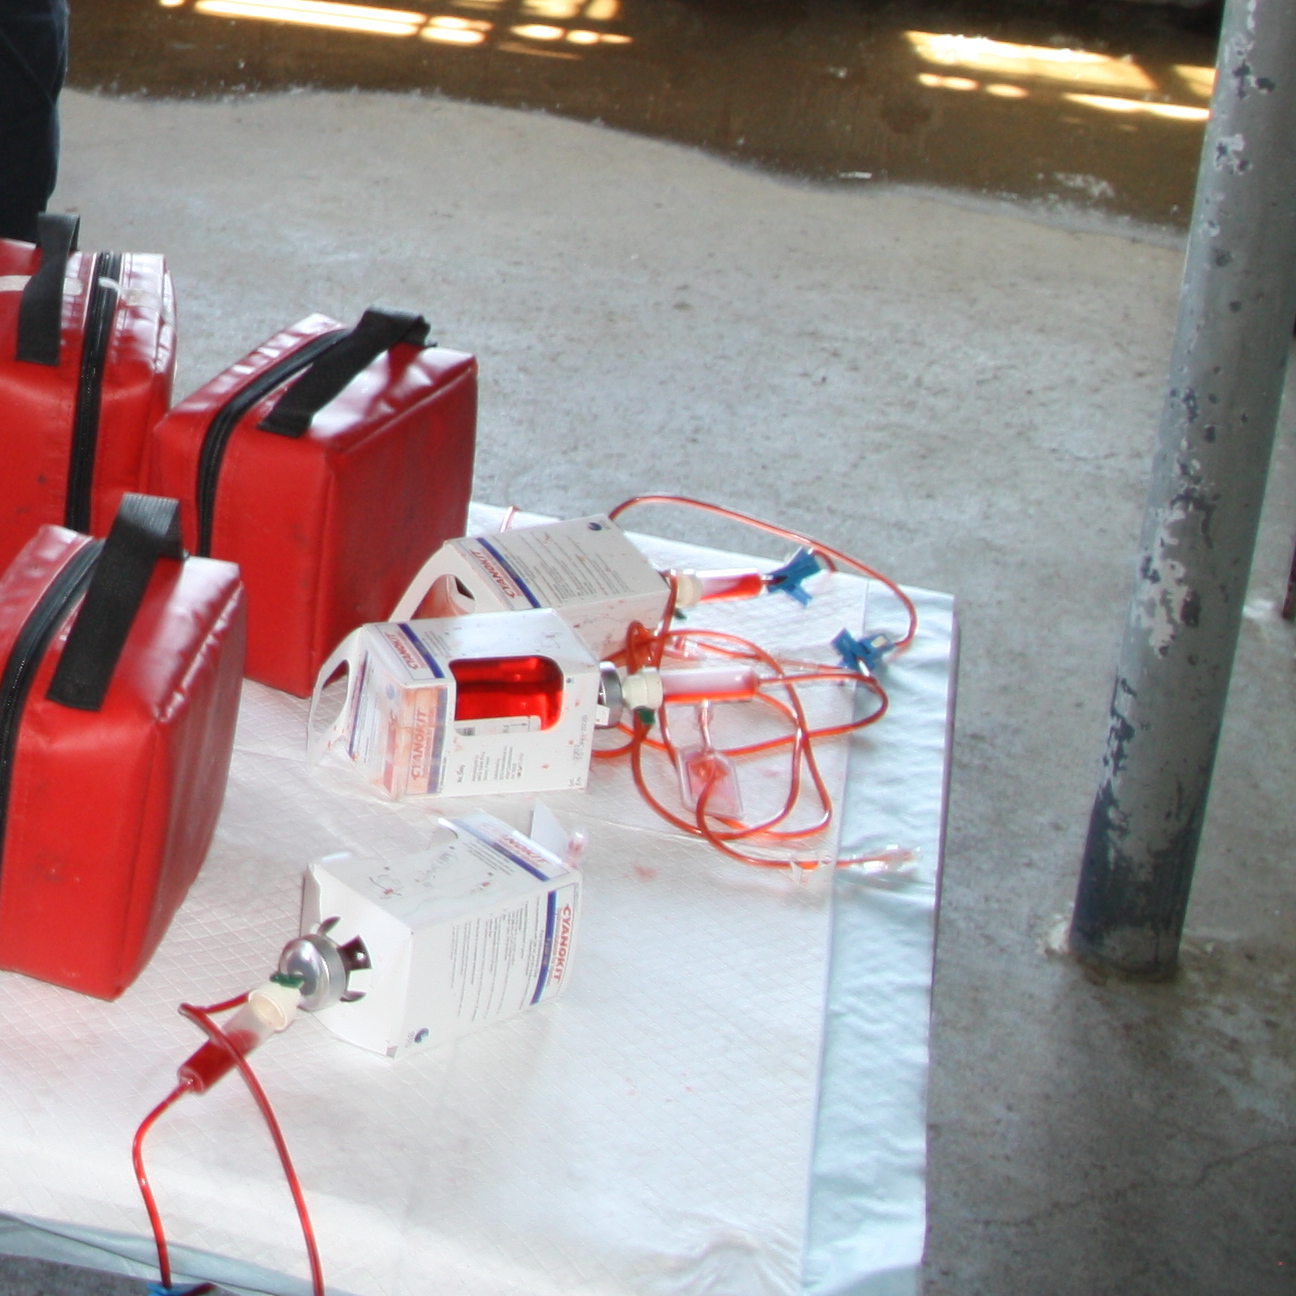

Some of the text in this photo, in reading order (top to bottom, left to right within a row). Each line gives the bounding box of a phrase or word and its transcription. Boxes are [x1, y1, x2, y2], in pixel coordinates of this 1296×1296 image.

[469, 549, 520, 600] CYANOKIT
[385, 632, 421, 672] CYANOKIT
[411, 709, 429, 779] CYANOKIT
[552, 902, 573, 982] CYANOKIT
